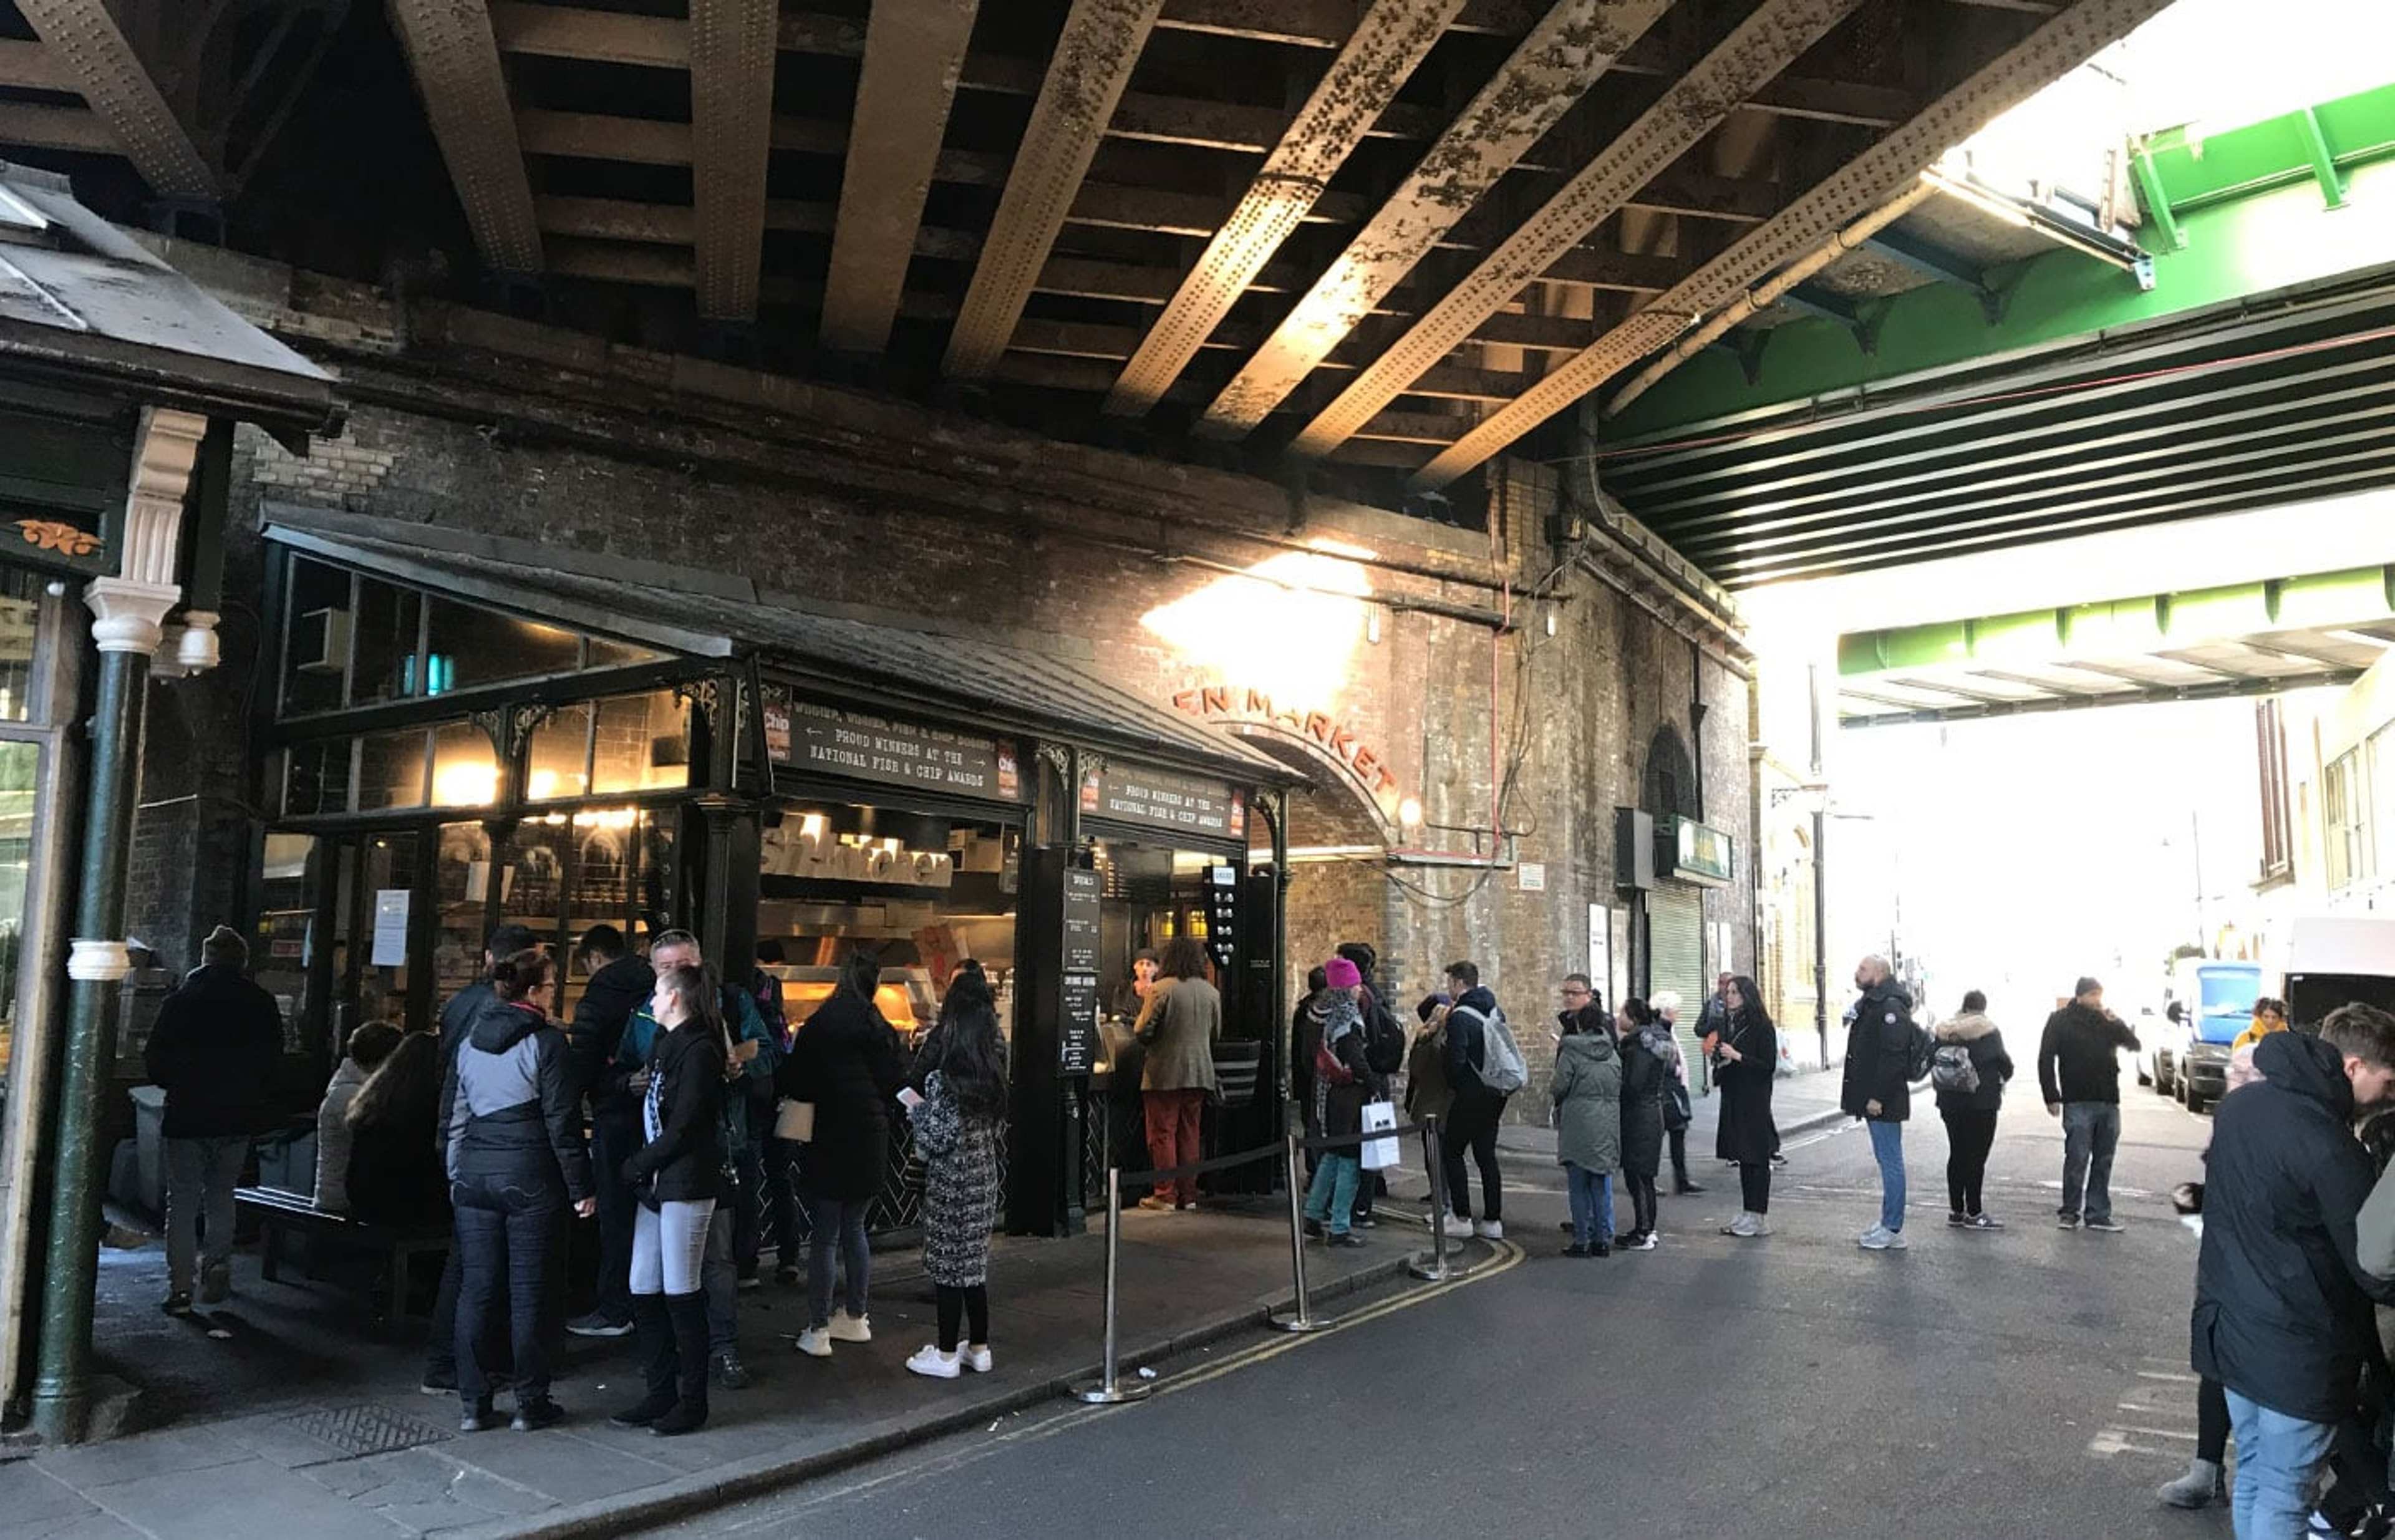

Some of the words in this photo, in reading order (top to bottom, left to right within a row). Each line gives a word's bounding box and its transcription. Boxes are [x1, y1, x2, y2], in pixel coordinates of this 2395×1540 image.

[810, 745, 867, 768] NATIONAL
[873, 755, 899, 773] FISH
[904, 762, 911, 775] &
[916, 764, 944, 780] CHIP
[947, 768, 984, 787] AWARDS
[835, 728, 870, 748] PROUD
[875, 737, 920, 757] WINNERS
[926, 747, 940, 761] AT
[944, 750, 962, 766] THE
